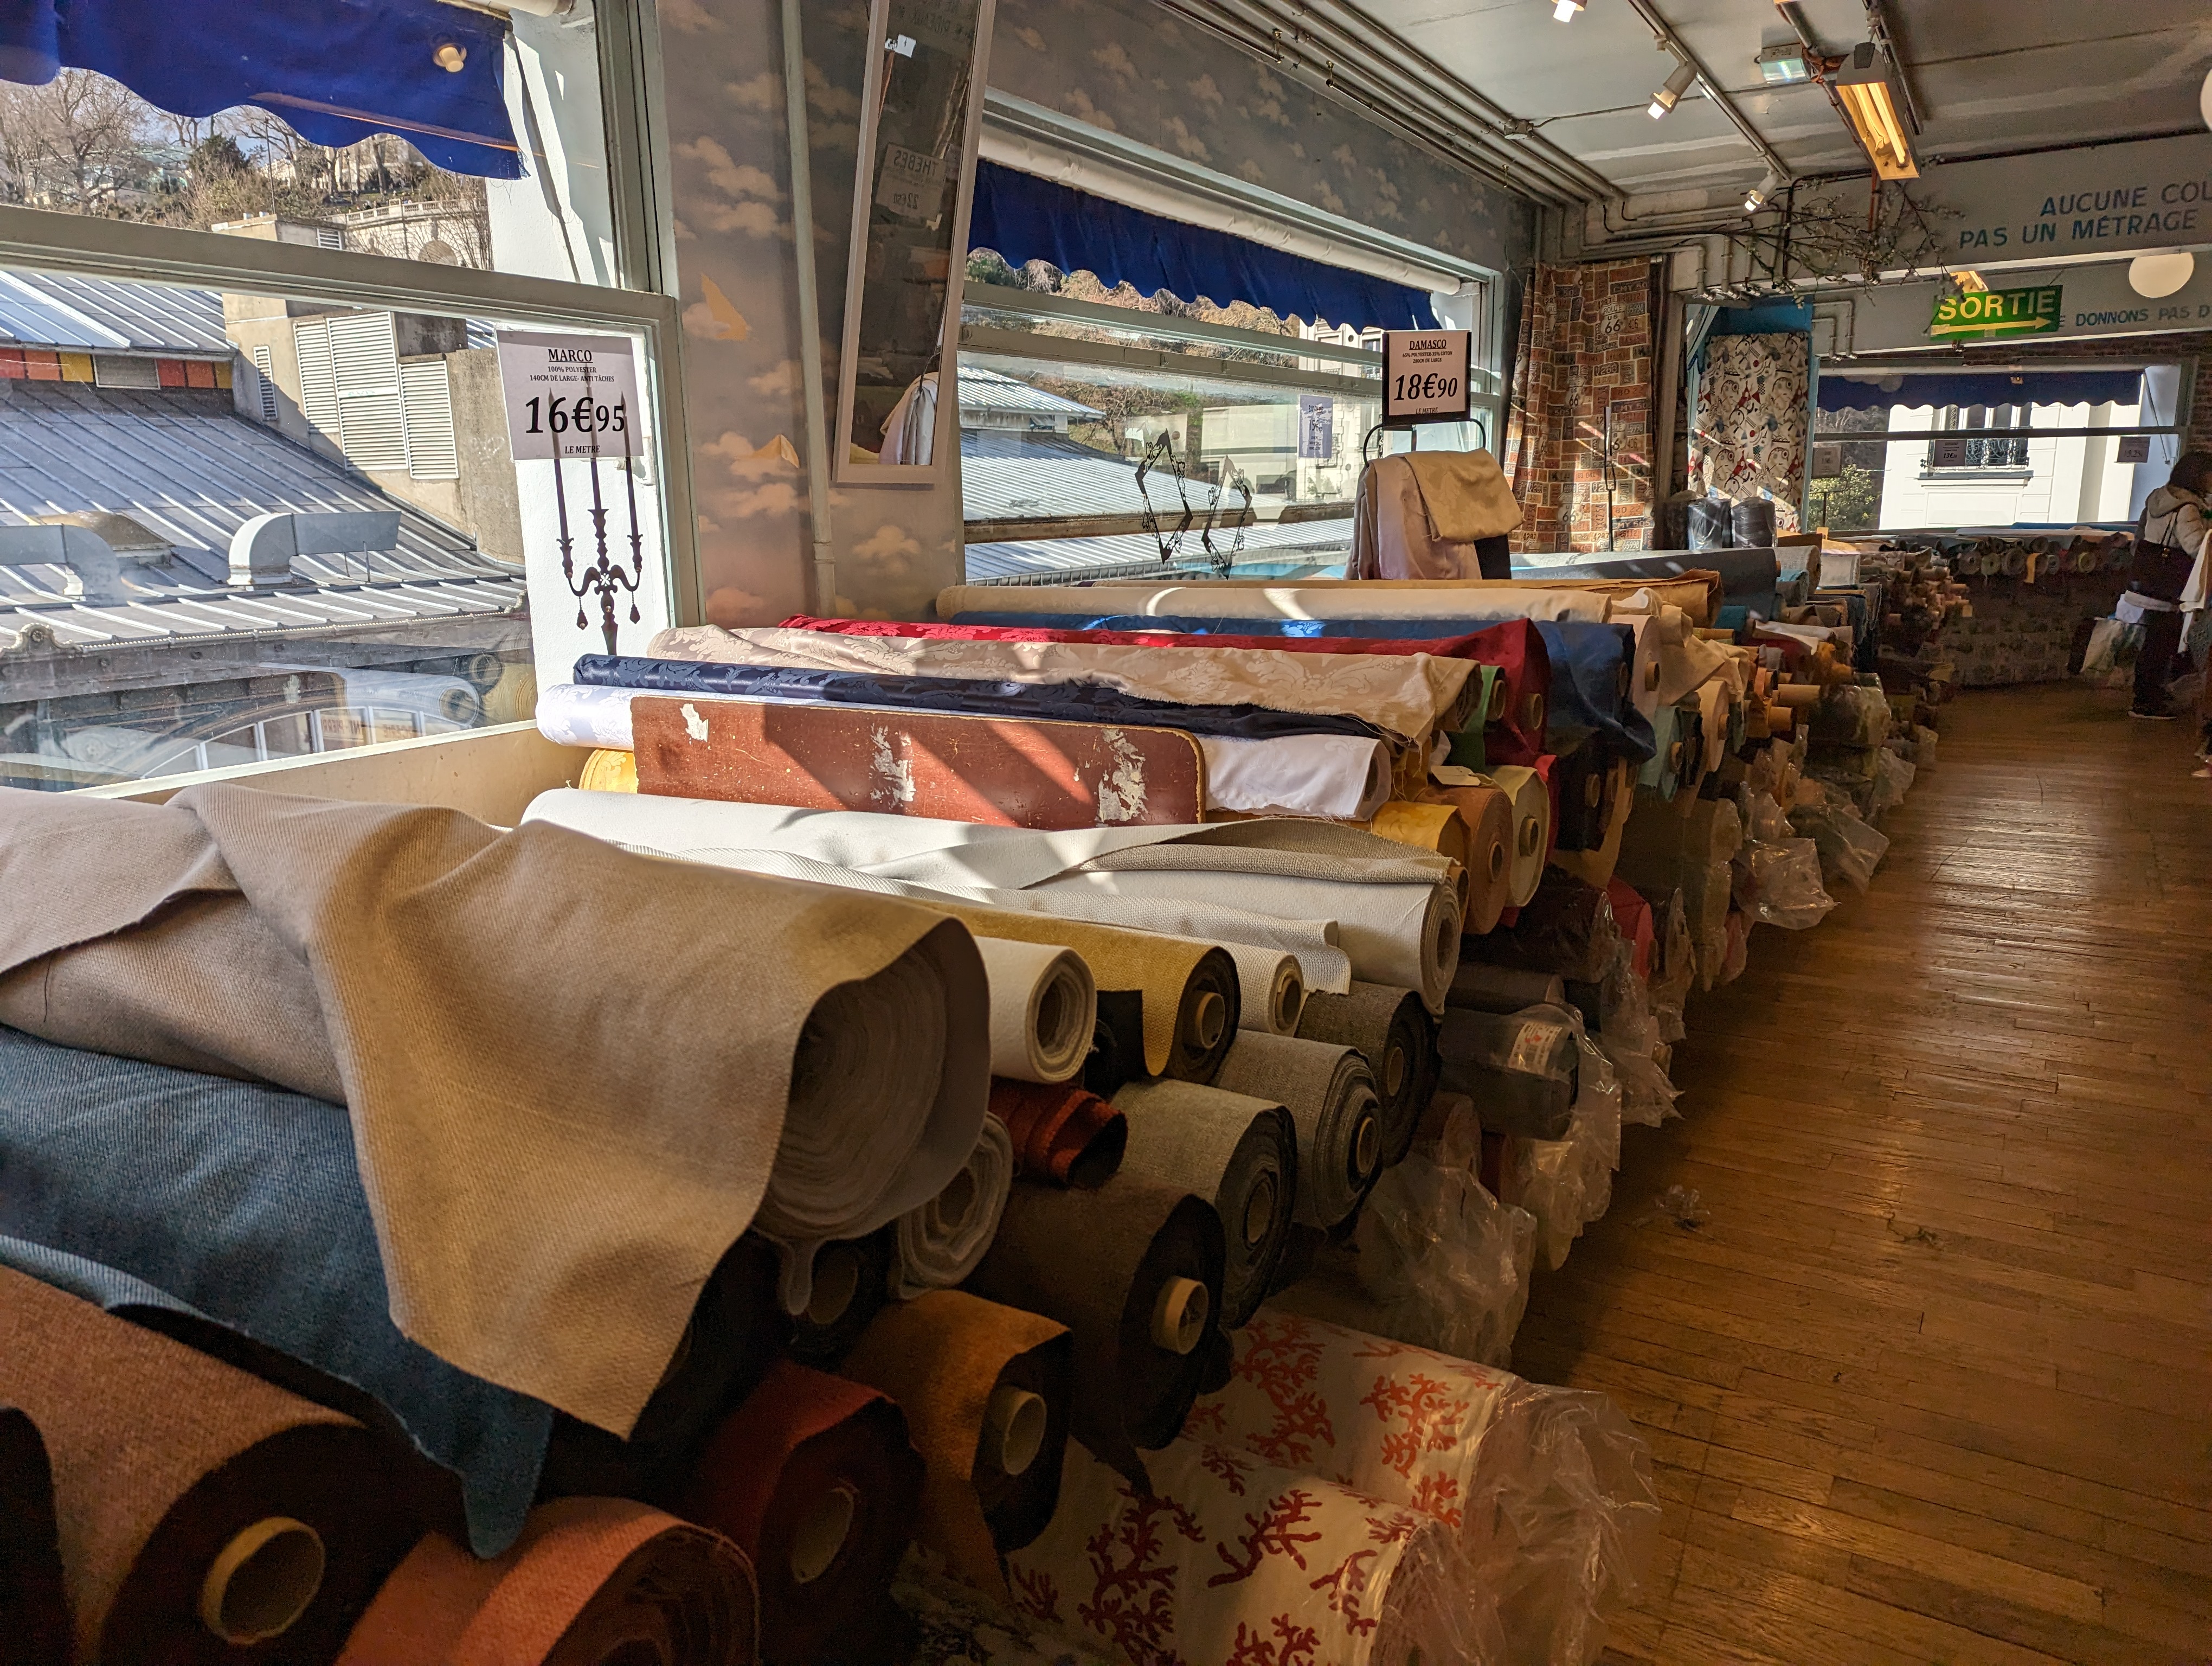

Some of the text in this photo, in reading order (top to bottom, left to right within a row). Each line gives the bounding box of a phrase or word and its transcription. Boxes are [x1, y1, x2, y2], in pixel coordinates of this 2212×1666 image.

[2040, 187, 2148, 217] AUCUNE
[1959, 208, 2199, 249] PAS UN MÉTRAGE
[1938, 290, 2056, 321] SORTIE
[2075, 309, 2149, 326] DONNONS
[2158, 305, 2191, 321] PAS
[1605, 319, 1621, 334] 66
[1409, 339, 1446, 350] DAMASCO
[548, 349, 593, 362] MARCO
[595, 374, 615, 382] TÂCHES
[1394, 373, 1458, 401] 18€90
[1568, 394, 1579, 406] 66
[525, 396, 625, 434] 16€95
[565, 445, 600, 454] LE METRE
[1562, 511, 1577, 522] 66
